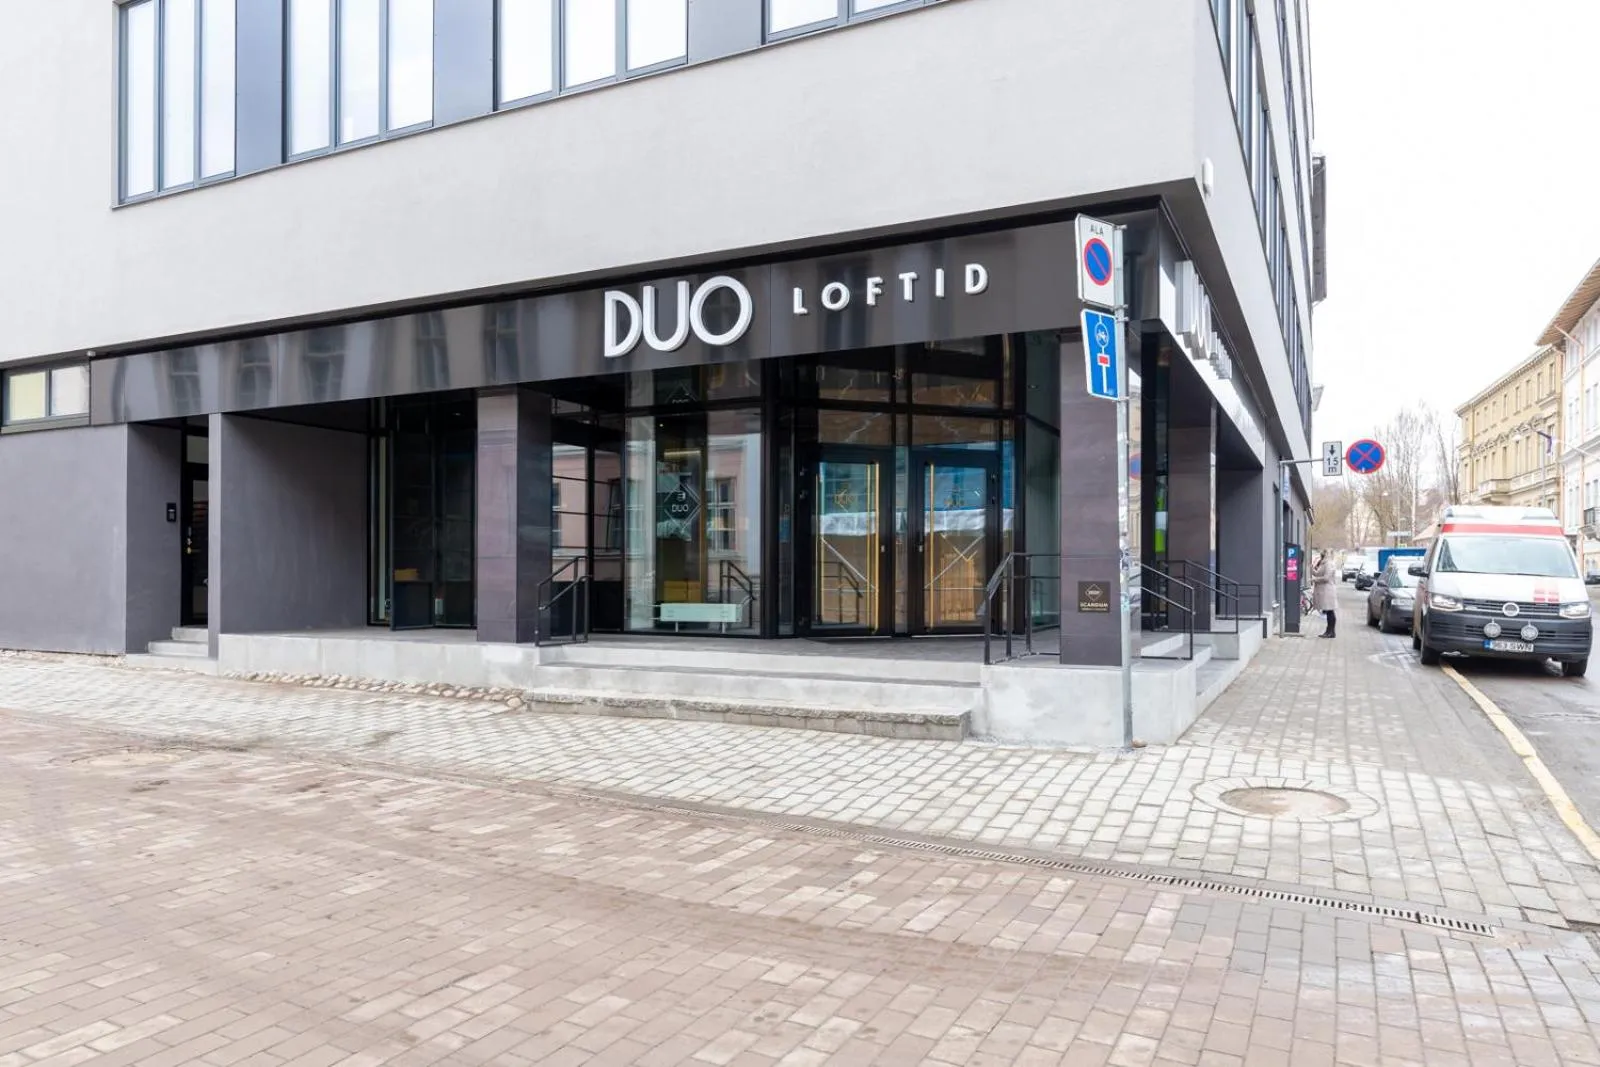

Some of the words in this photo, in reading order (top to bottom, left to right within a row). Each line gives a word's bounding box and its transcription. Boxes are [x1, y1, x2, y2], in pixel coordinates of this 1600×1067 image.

[1090, 223, 1104, 236] ALA
[604, 275, 753, 358] DUO
[793, 263, 989, 315] LOFTID
[1327, 457, 1339, 466] 15
[672, 503, 689, 512] DUO
[1288, 548, 1295, 557] P
